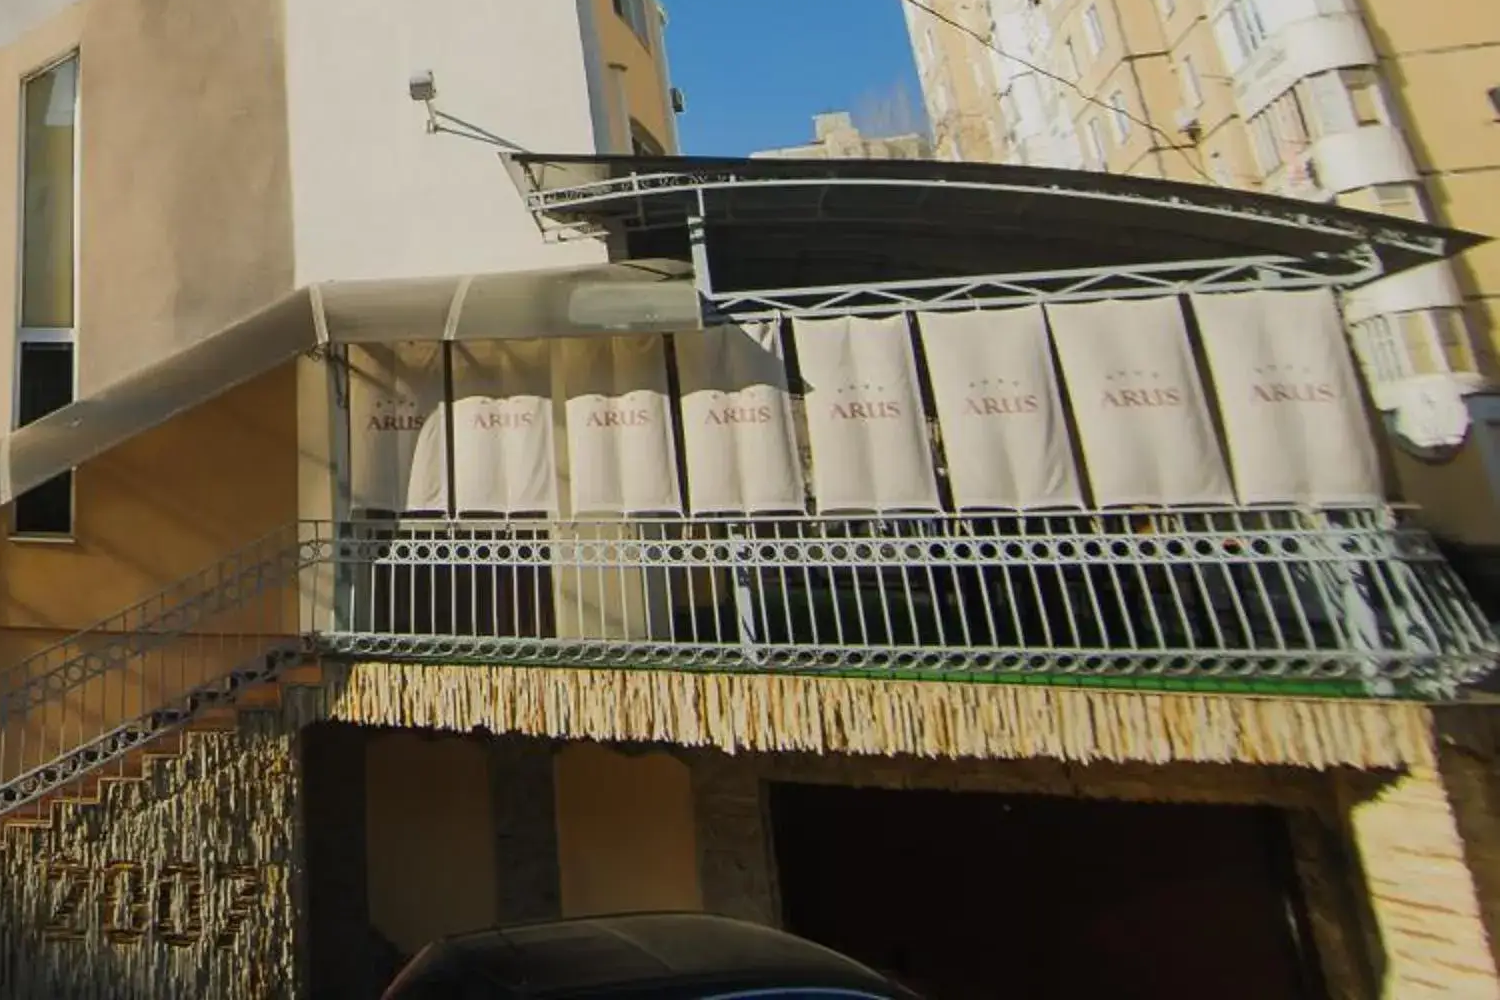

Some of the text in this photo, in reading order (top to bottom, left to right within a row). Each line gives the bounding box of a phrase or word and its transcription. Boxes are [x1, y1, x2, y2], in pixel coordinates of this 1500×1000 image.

[1103, 387, 1181, 409] ARUS
[1250, 382, 1336, 404] ARUS
[705, 405, 772, 426] ARUS
[830, 401, 902, 422] ARUS
[963, 394, 1040, 417] ARUS
[367, 415, 426, 432] ARUS
[473, 411, 533, 430] ARUS
[586, 408, 652, 428] ARUS
